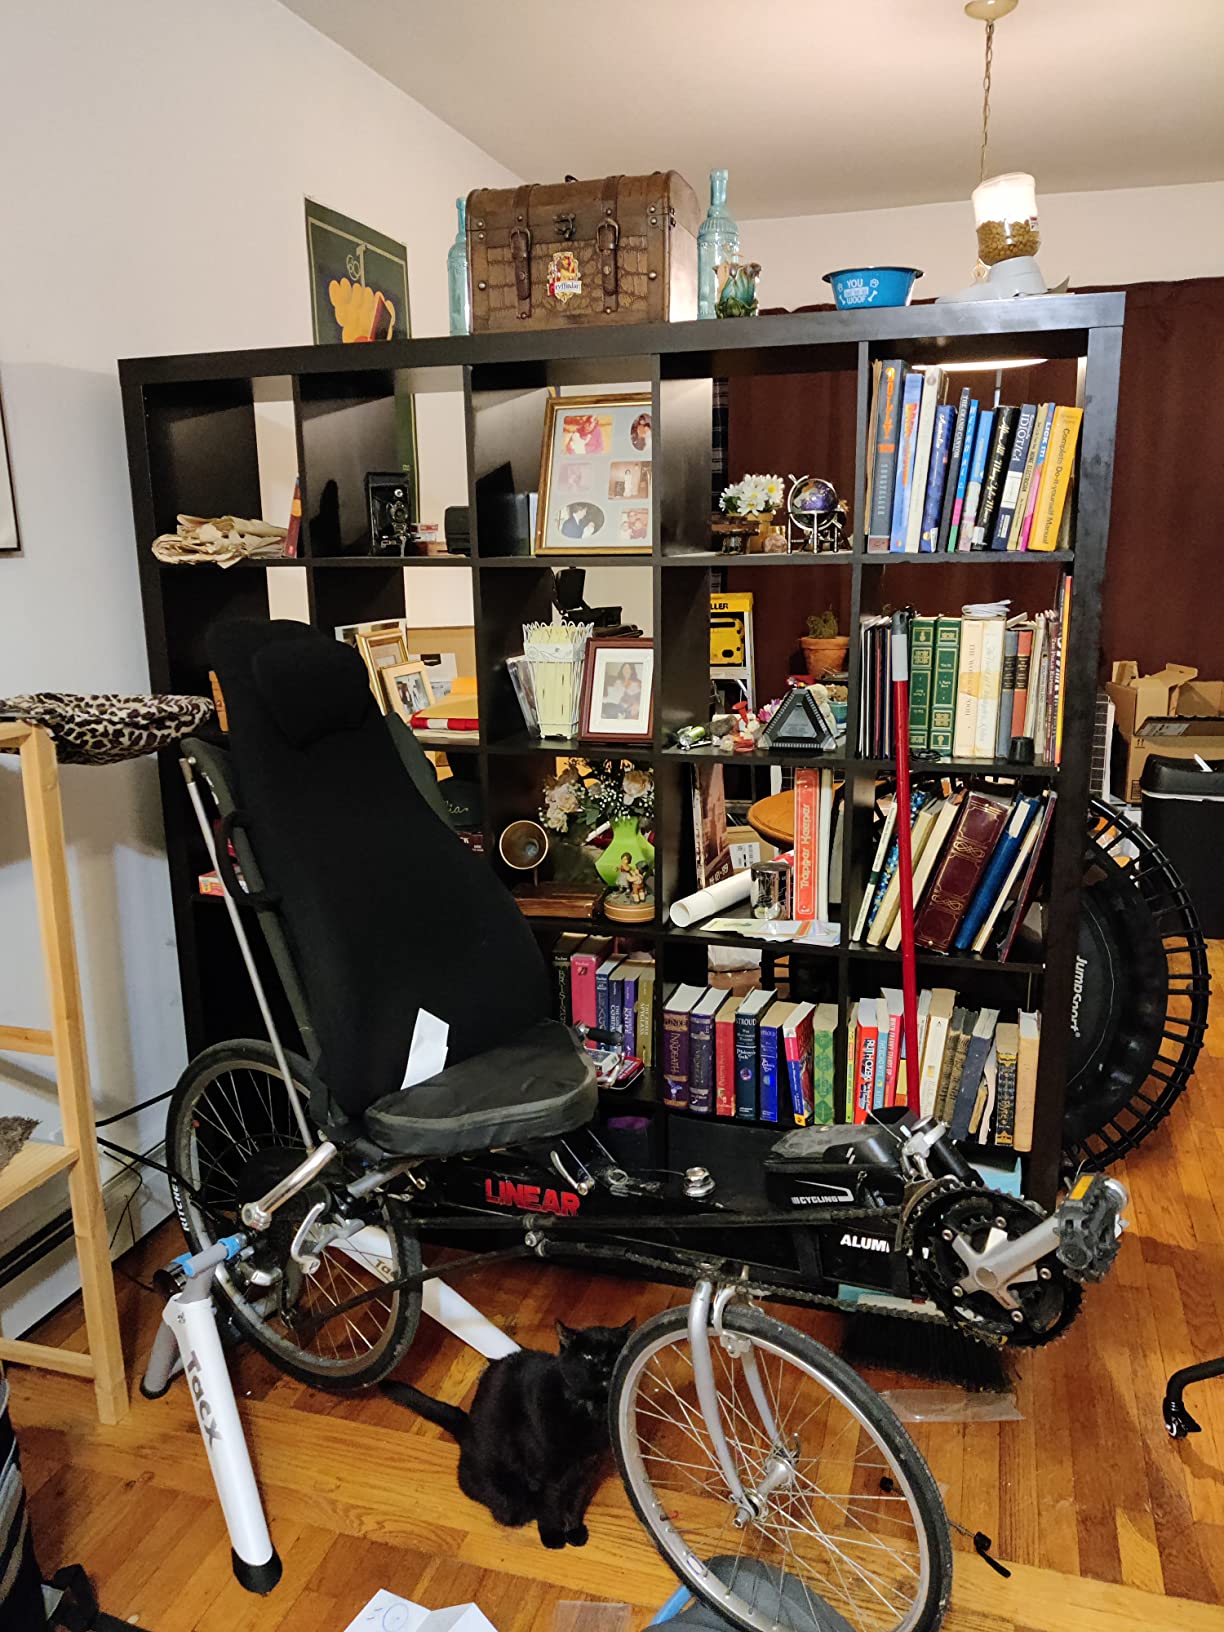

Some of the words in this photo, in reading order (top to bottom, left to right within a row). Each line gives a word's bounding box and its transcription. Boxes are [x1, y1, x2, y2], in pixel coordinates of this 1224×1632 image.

[847, 279, 863, 289] YOU
[1012, 413, 1030, 462] IDIOTICA
[1043, 422, 1052, 443] LICK
[1058, 428, 1071, 465] Complete
[1043, 517, 1054, 544] Manual
[800, 803, 812, 845] Keeper
[800, 848, 812, 889] Trapper
[669, 1032, 681, 1074] INKDEATH
[866, 1039, 876, 1060] RUTH
[485, 1179, 580, 1216] LINEAR
